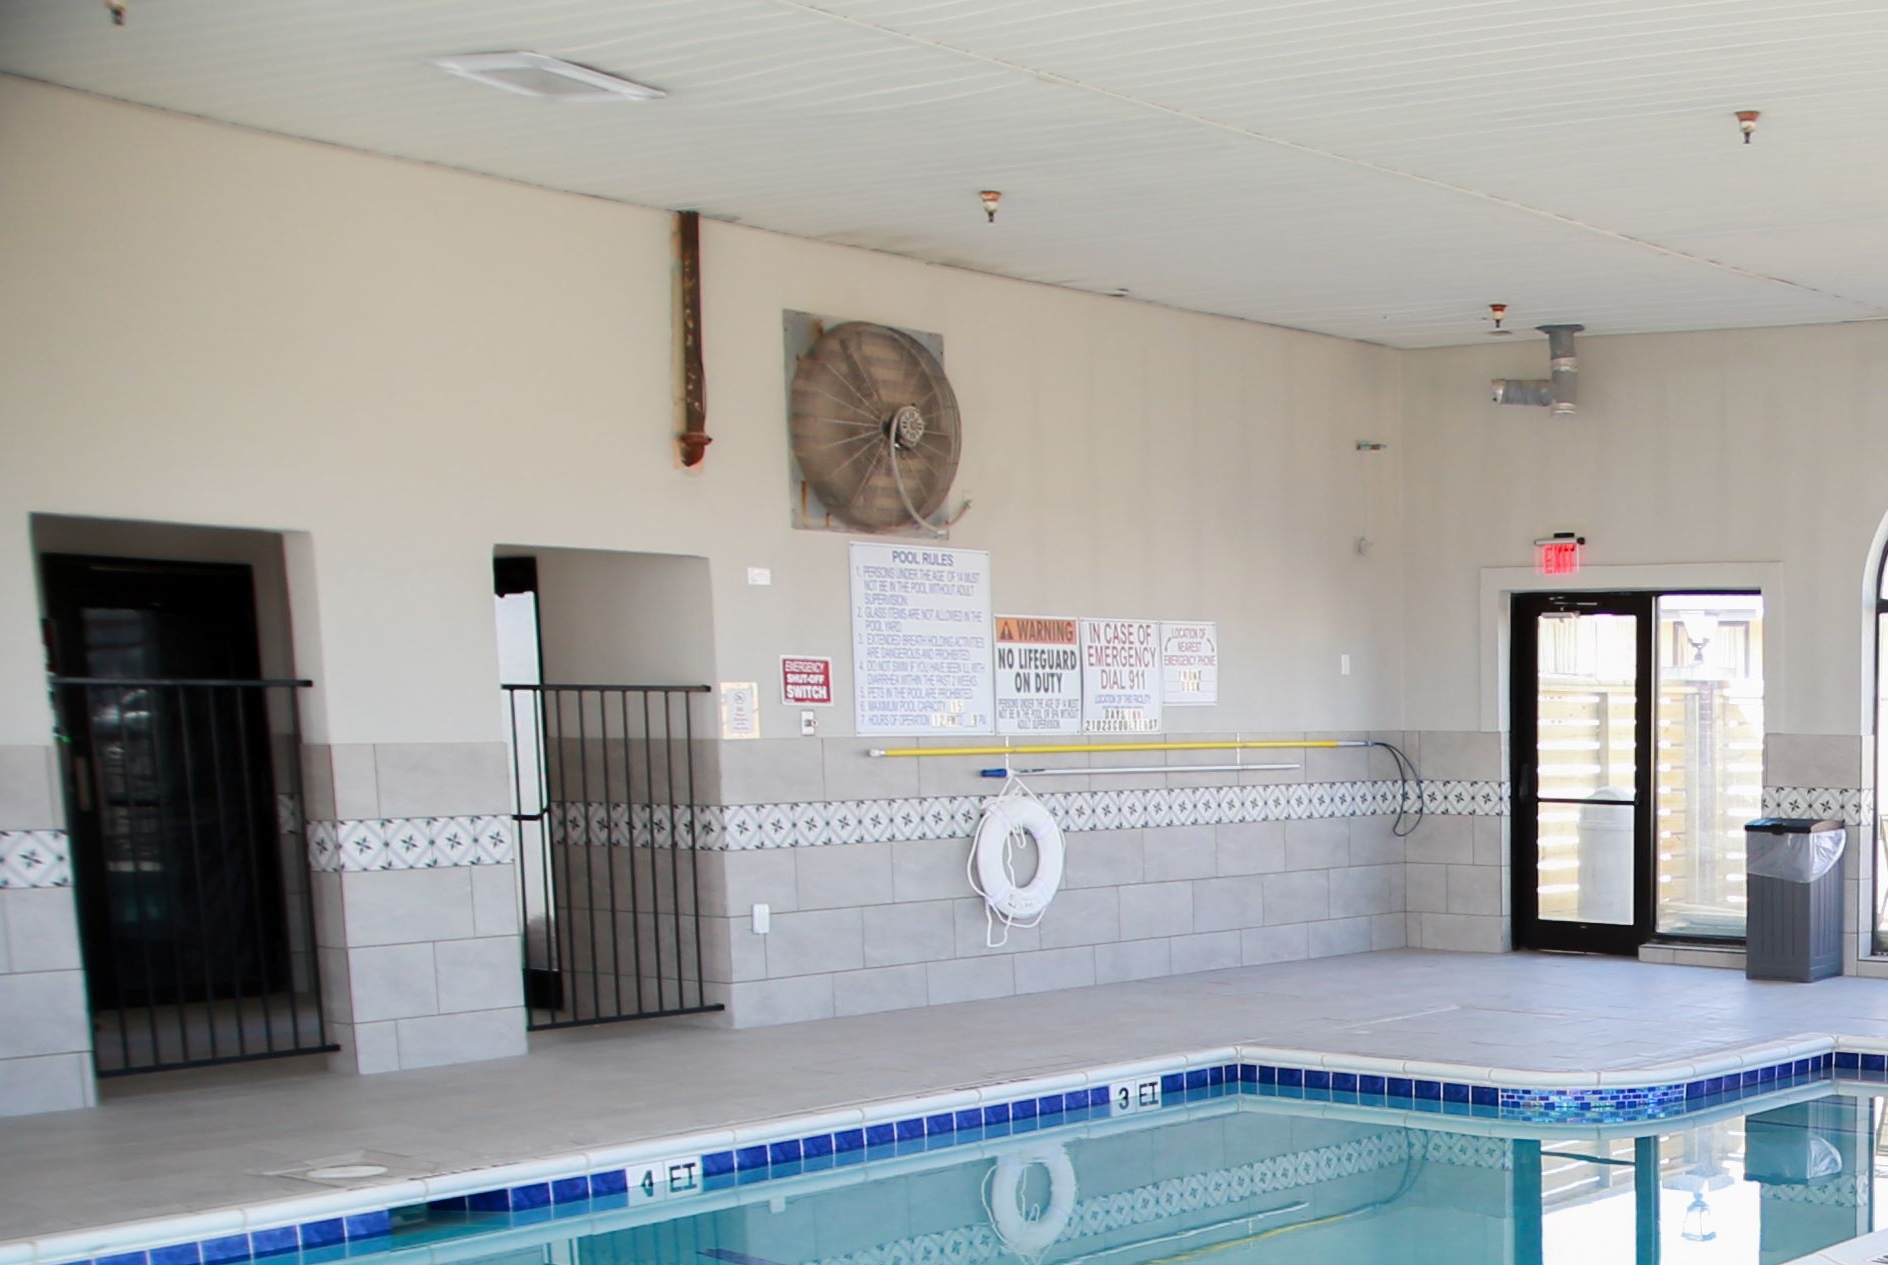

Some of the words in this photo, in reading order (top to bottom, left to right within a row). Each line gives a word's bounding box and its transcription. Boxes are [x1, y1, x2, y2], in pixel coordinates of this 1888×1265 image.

[892, 550, 920, 564] POOL
[922, 552, 954, 567] RULES
[1544, 545, 1575, 574] EXIT
[1016, 619, 1073, 642] WARNING
[1089, 623, 1100, 644] IN
[1103, 623, 1134, 645] CASE
[1137, 624, 1151, 645] OF
[785, 661, 825, 673] EMERGENCY
[998, 648, 1014, 670] NO
[1018, 648, 1076, 671] LIFEGUARD
[1087, 645, 1156, 668] EMERGENCY
[1164, 655, 1196, 666] EMERGENCY
[786, 673, 825, 684] SHUT-OFF
[1015, 672, 1030, 693] ON
[1035, 673, 1063, 693] DUTY
[1100, 669, 1126, 689] DIAL
[1129, 670, 1146, 690] 911
[786, 684, 828, 699] SWITCH
